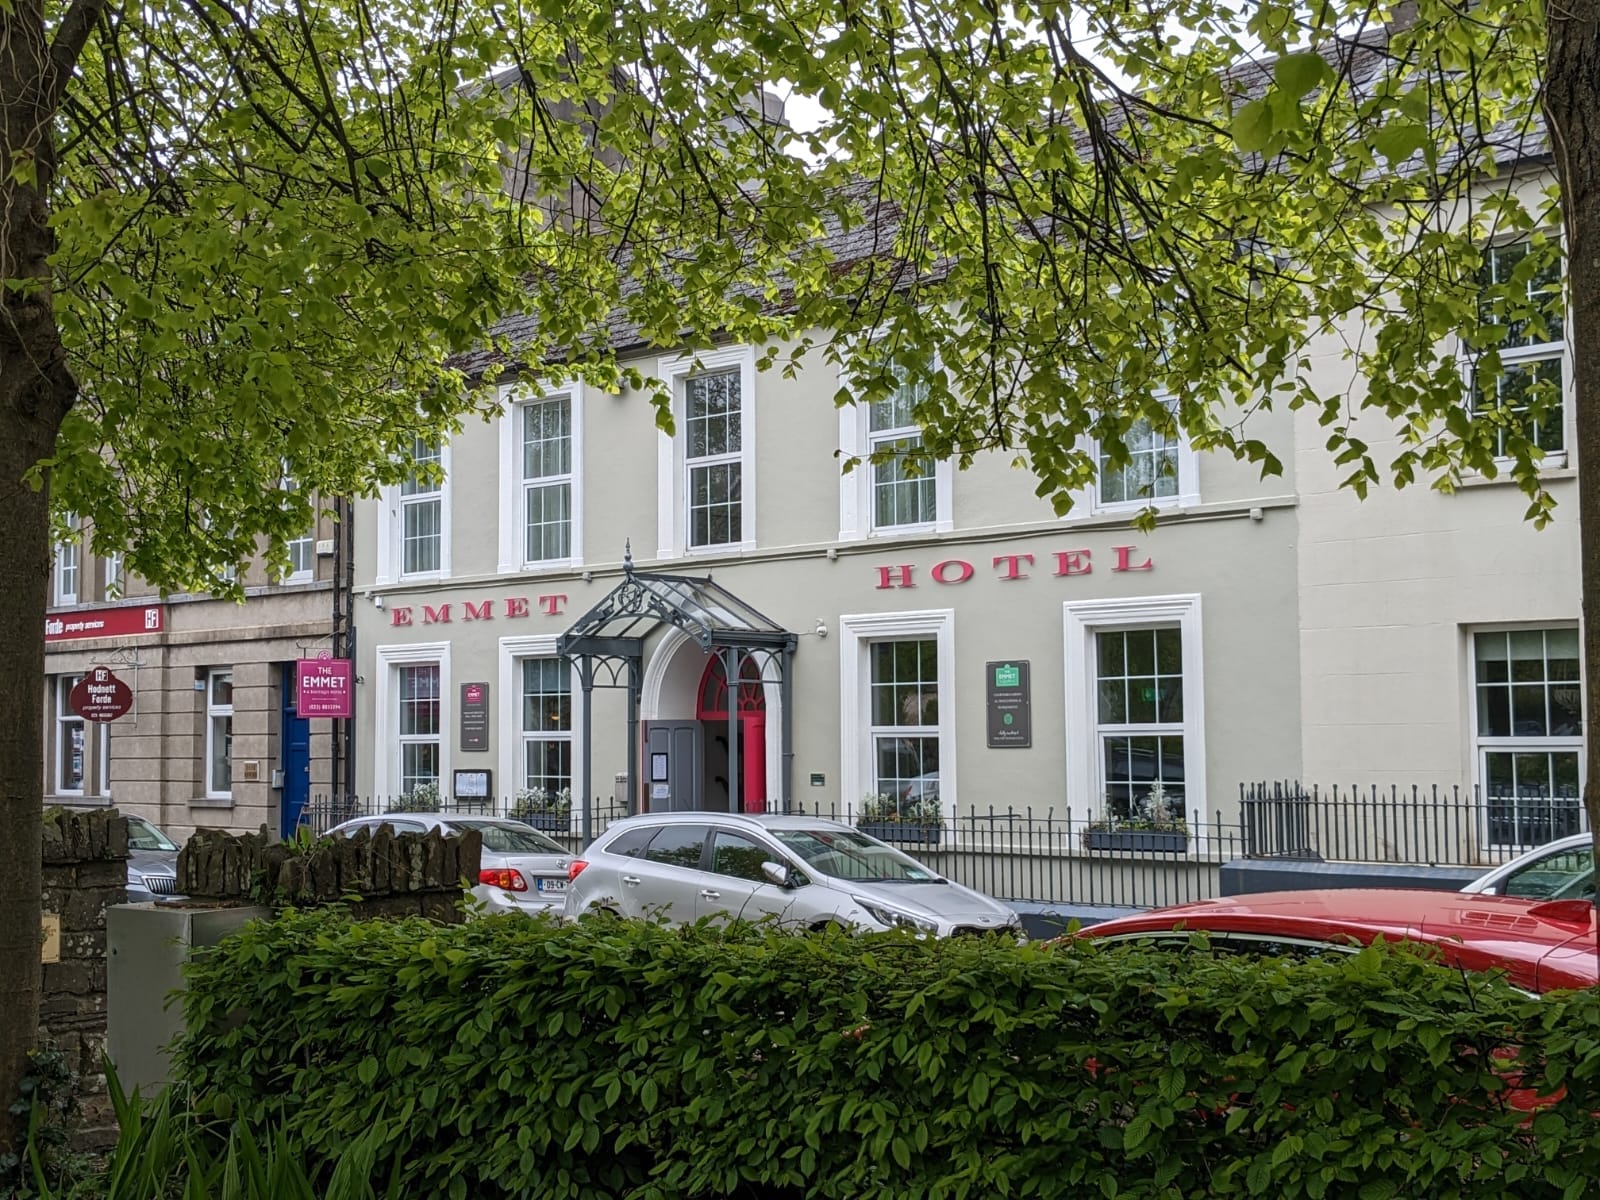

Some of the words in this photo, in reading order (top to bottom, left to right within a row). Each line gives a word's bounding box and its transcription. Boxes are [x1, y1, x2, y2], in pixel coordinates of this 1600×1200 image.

[874, 545, 1153, 590] HOTEL
[390, 594, 568, 627] EMMET
[45, 618, 63, 635] Forde
[318, 666, 332, 675] THE
[303, 676, 346, 688] EMMET
[91, 694, 112, 704] Forde
